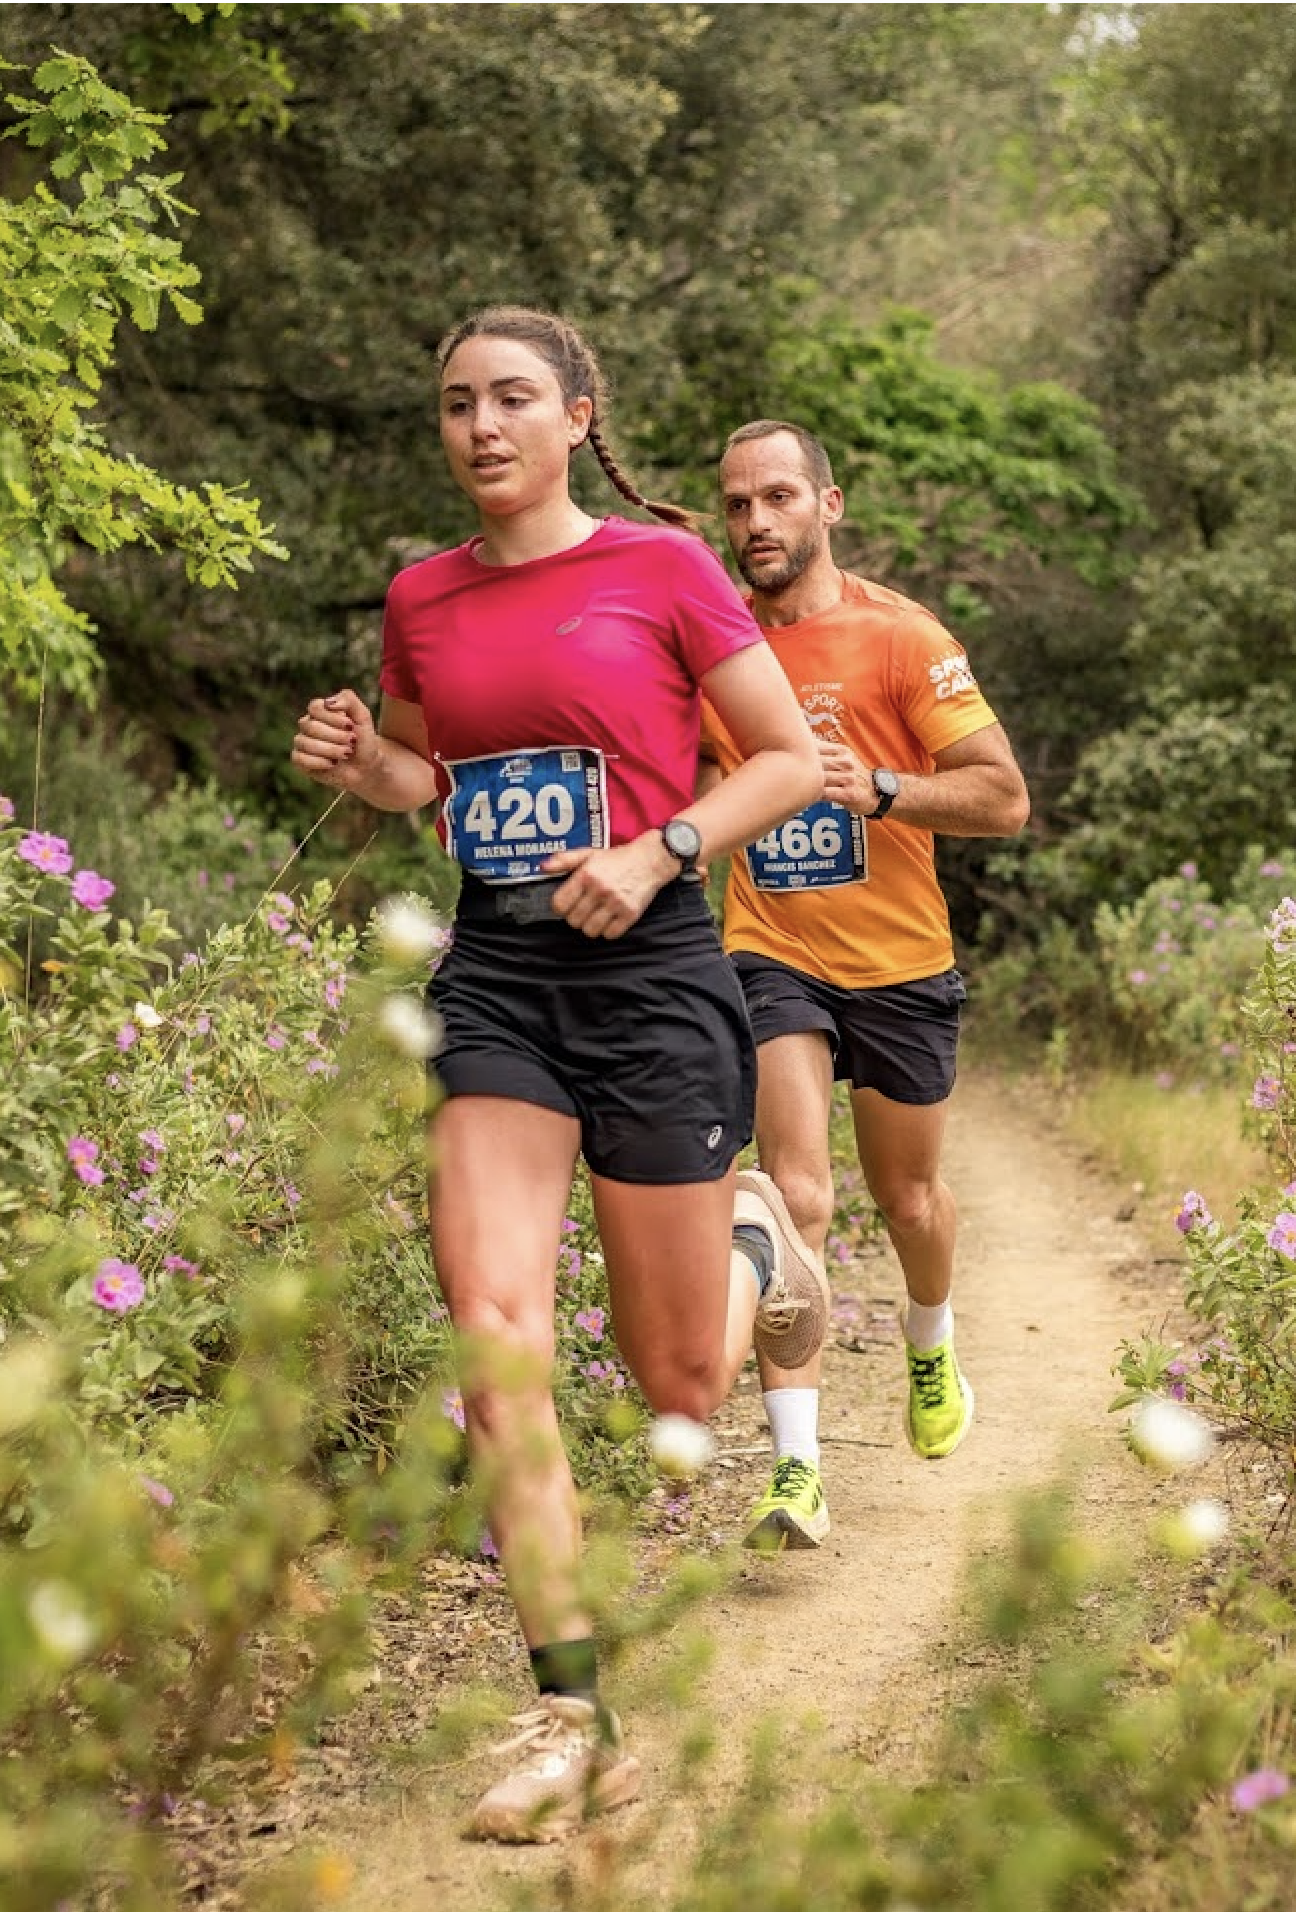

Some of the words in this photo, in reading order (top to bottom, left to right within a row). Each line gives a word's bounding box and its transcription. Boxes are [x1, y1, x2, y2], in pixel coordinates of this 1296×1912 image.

[585, 766, 599, 785] 420
[464, 783, 575, 842] 420
[474, 844, 515, 859] HELENA
[516, 840, 567, 856] MORAGAS
[755, 816, 842, 860] 466
